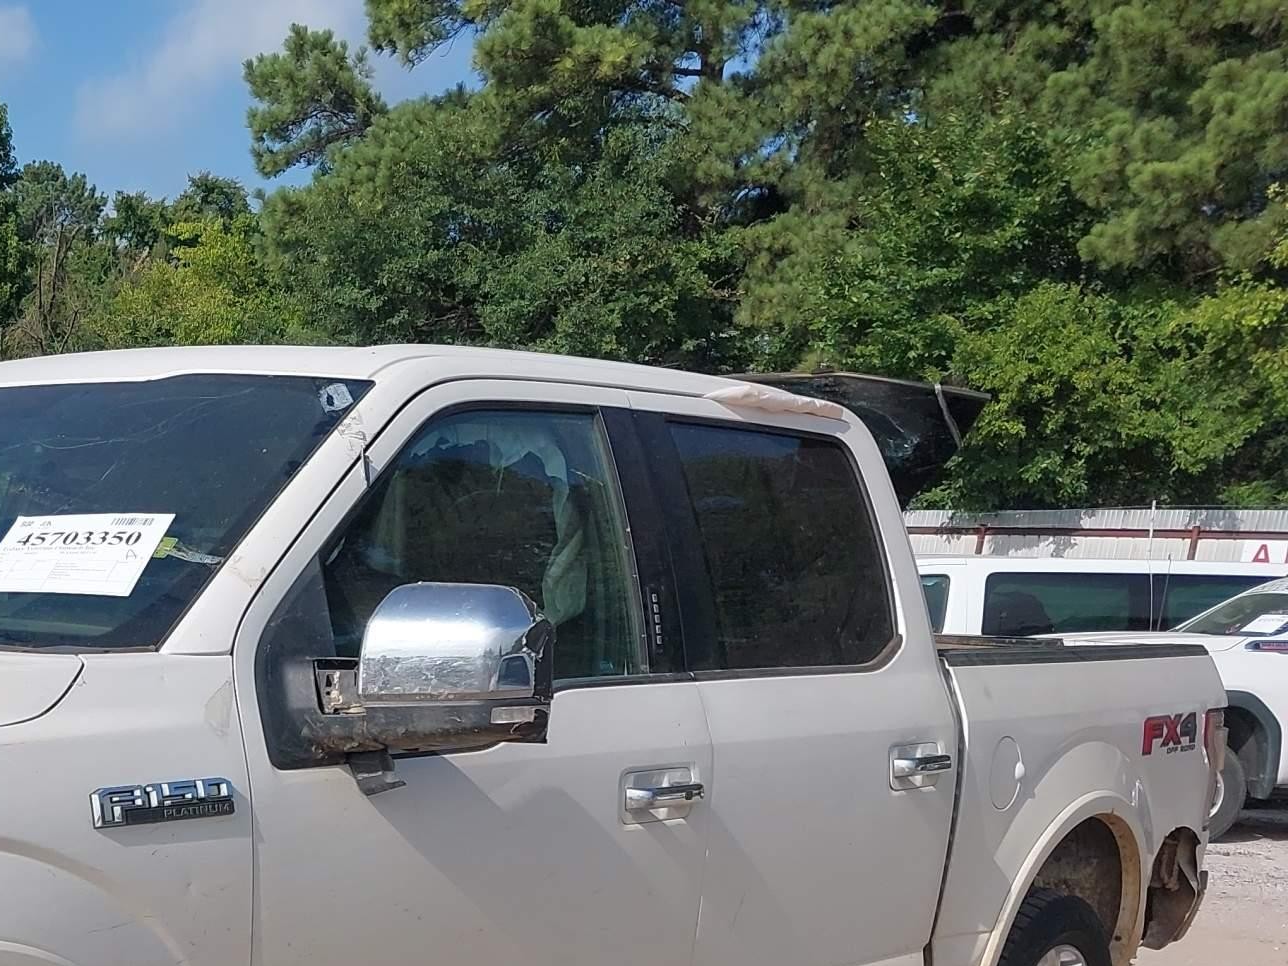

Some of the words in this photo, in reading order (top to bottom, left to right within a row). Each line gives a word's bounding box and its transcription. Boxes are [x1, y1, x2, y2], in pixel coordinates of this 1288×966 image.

[16, 530, 142, 547] 45703350
[1142, 711, 1197, 756] FX4
[163, 802, 231, 818] PLATINUM
